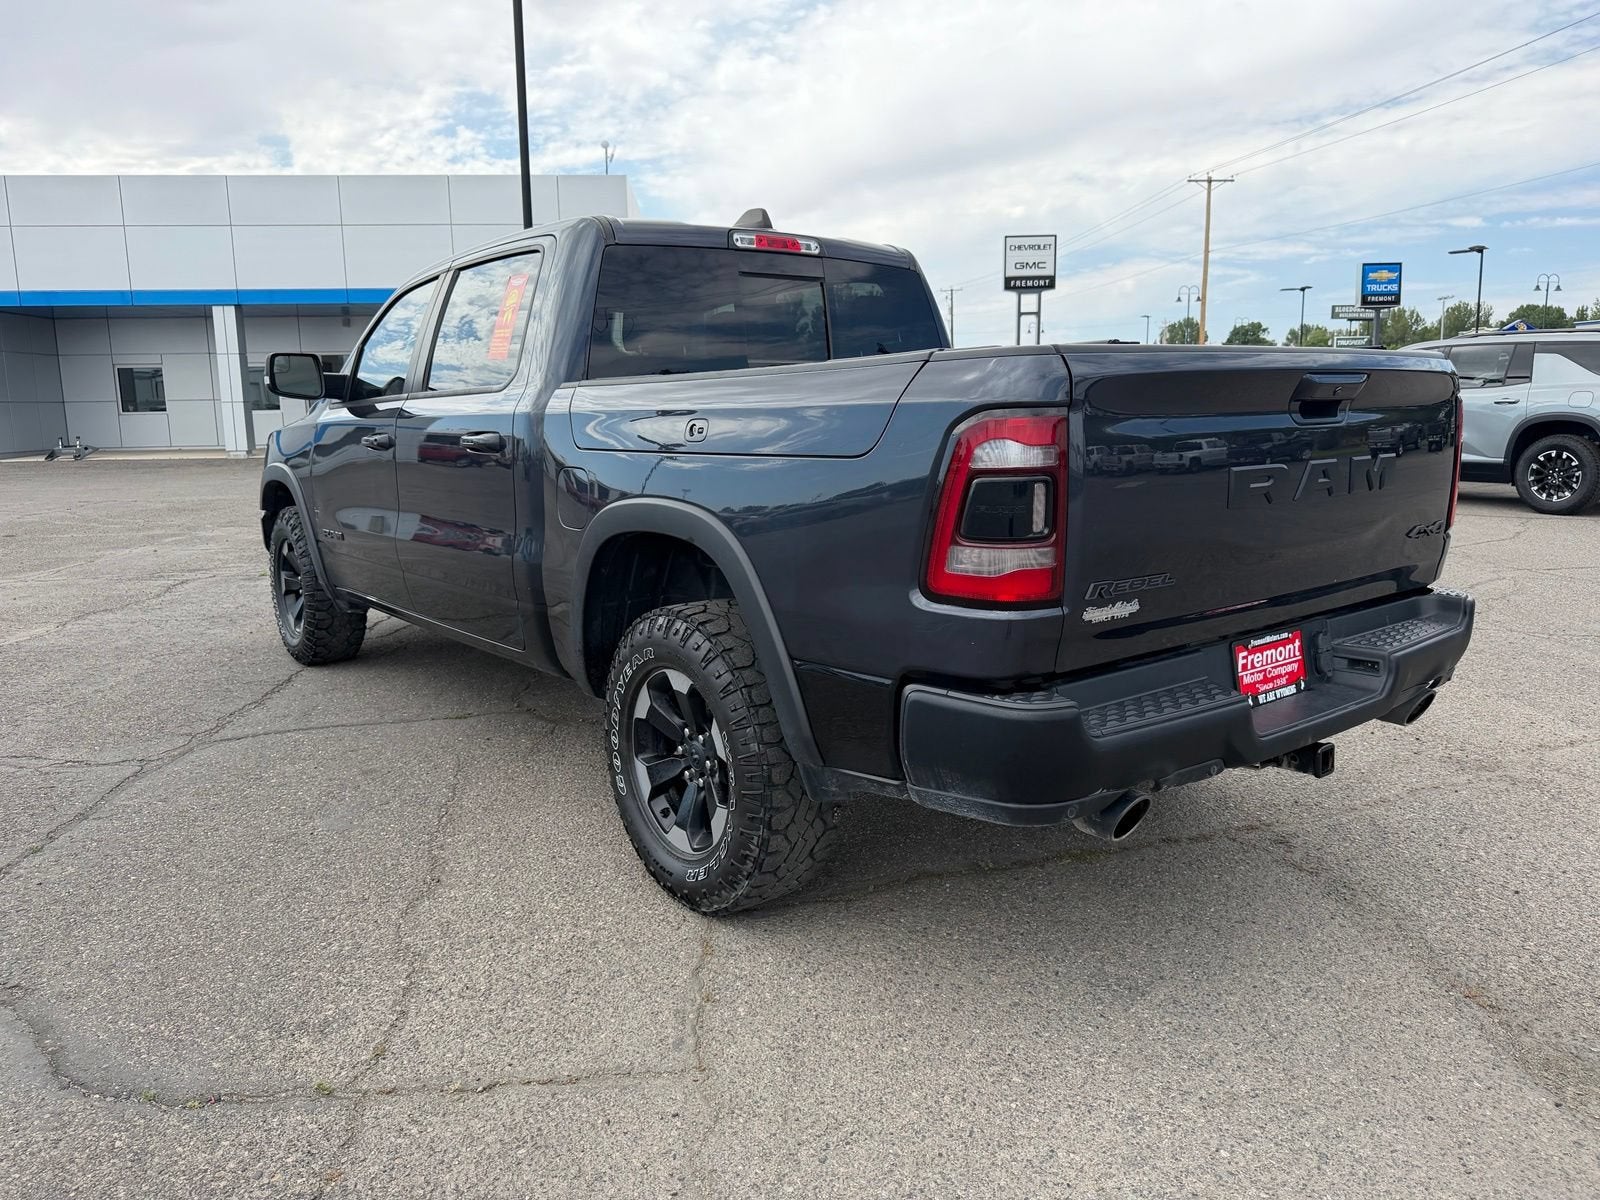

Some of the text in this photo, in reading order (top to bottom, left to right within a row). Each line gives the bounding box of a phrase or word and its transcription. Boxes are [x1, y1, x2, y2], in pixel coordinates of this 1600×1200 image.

[1014, 261, 1047, 269] GMC
[1010, 279, 1050, 287] FREMONT
[1366, 284, 1398, 292] TRUCKS
[1227, 453, 1398, 508] RAM
[1085, 573, 1176, 600] REBEL
[1238, 639, 1300, 672] Fremont
[1243, 661, 1299, 686] Motor Company
[1258, 693, 1267, 704] WE
[1267, 690, 1276, 702] ARE
[611, 647, 655, 796] GOODYEAR
